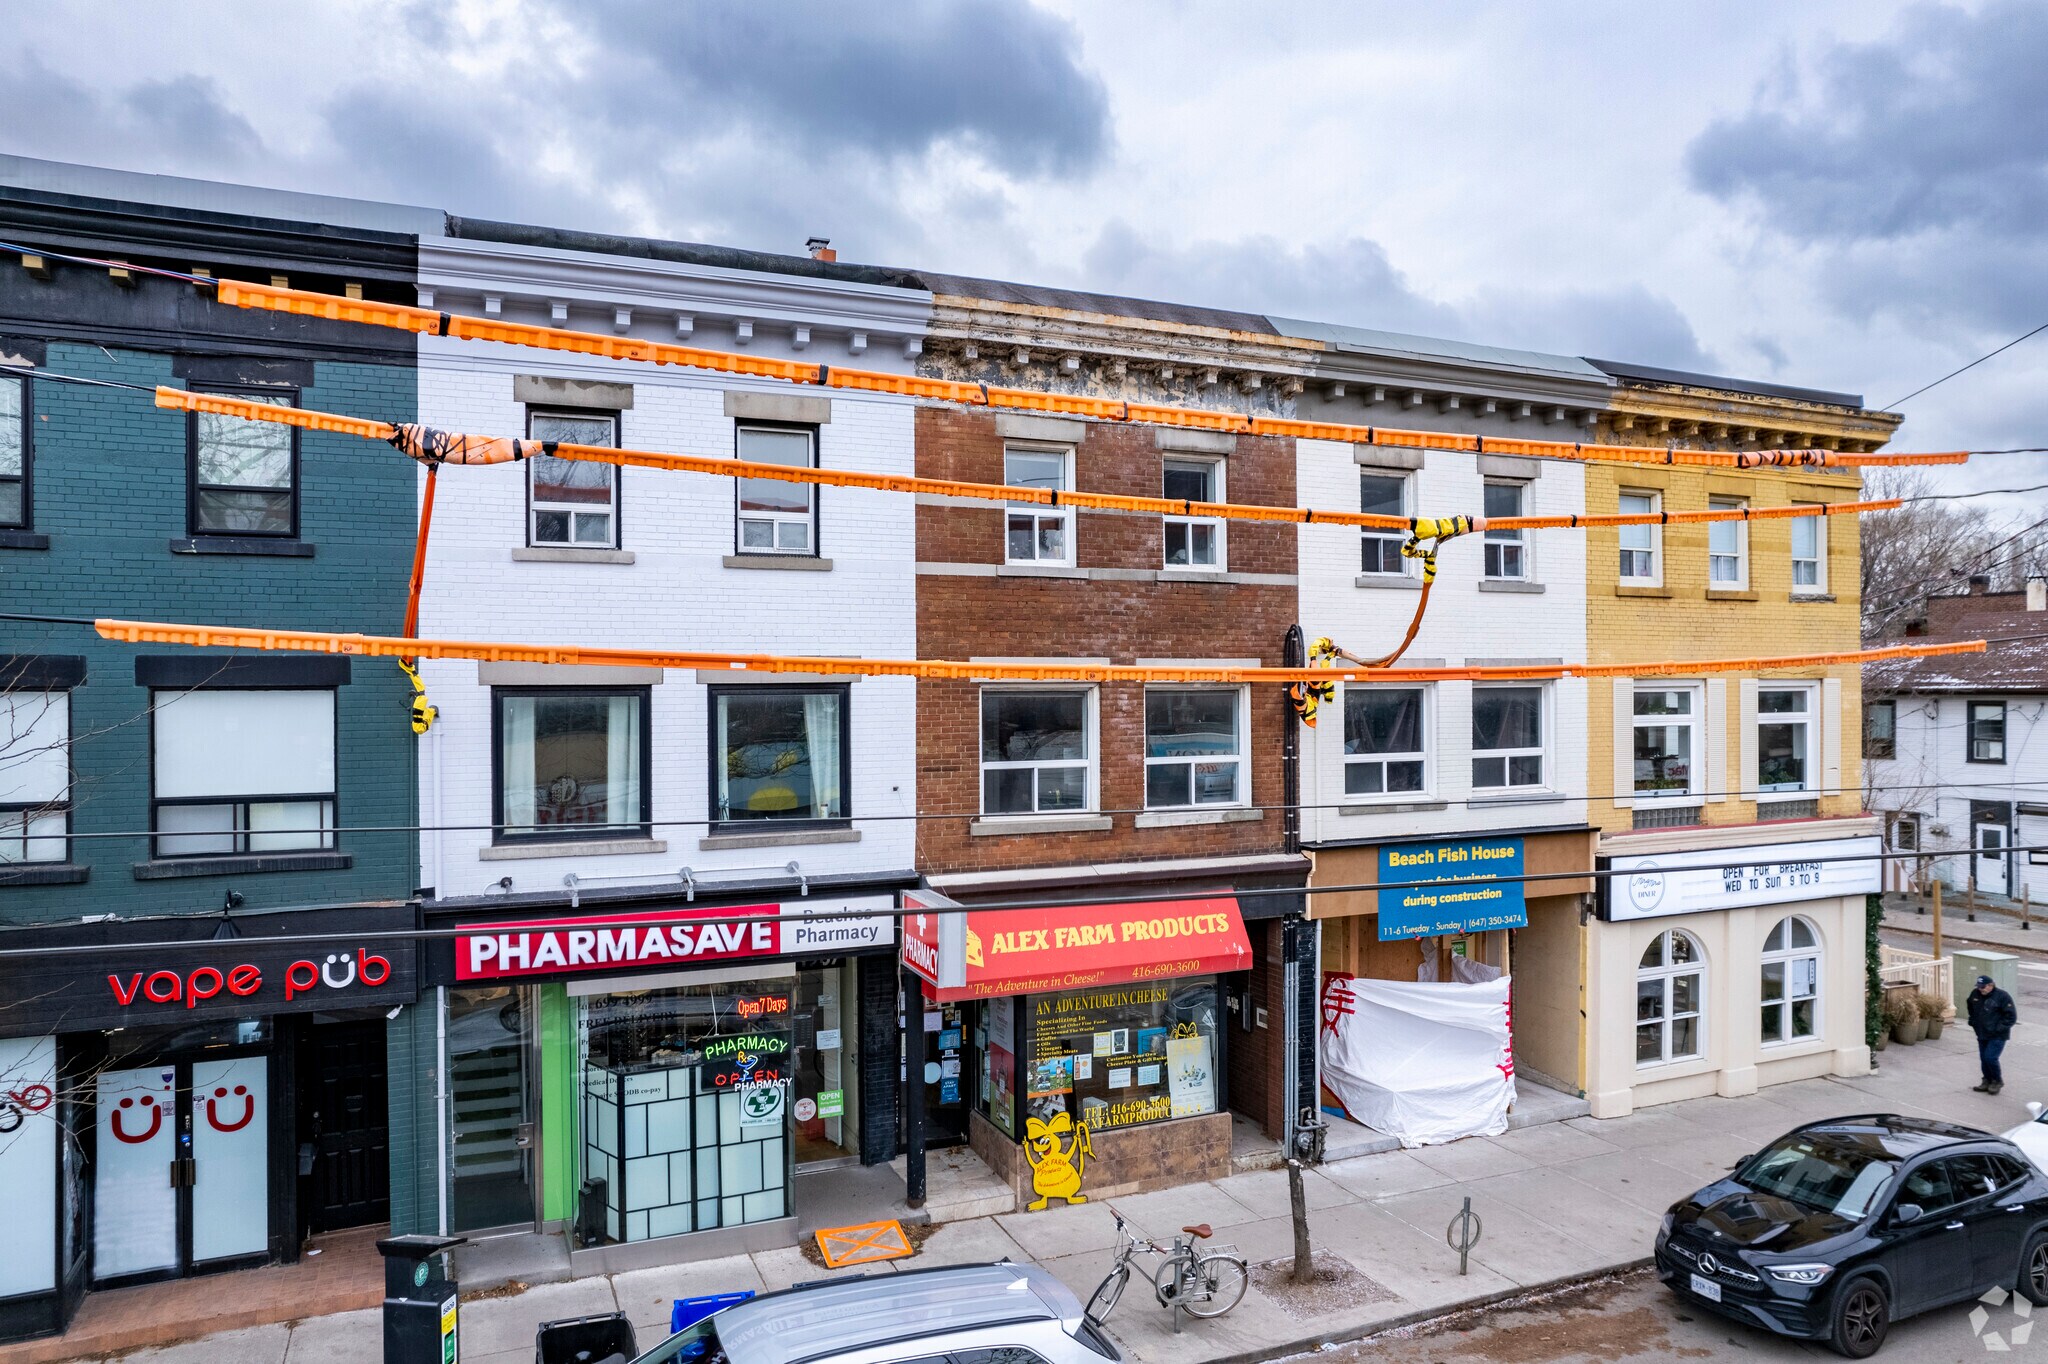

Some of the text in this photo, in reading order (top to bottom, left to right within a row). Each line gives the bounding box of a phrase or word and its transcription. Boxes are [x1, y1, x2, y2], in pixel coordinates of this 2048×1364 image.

[1389, 846, 1515, 867] Beach Fish House
[1722, 866, 1744, 879] OPEN
[1725, 880, 1742, 892] WED
[1749, 878, 1759, 890] TO
[1789, 875, 1795, 886] 9
[1799, 873, 1811, 885] TO
[1814, 872, 1820, 883] 9
[1403, 888, 1502, 907] during construction
[1638, 890, 1656, 898] DINER
[796, 926, 878, 943] Pharmacy
[991, 913, 1229, 955] ALEX FARM PRODUCTS
[1384, 927, 1401, 936] 11-6
[1402, 923, 1430, 934] Tuesday
[1436, 920, 1462, 931] Sunday
[1468, 917, 1487, 928] (647)
[1488, 914, 1522, 926] 350-3474
[469, 919, 772, 973] PHARMASAVE
[905, 933, 938, 976] PHARMACY
[108, 964, 263, 1009] vape
[968, 960, 1201, 995] "The Adventure in Cheese!" 416-690-3600
[738, 995, 787, 1018] Open 7 Days
[1036, 988, 1168, 1015] AN ADVENTURE IN CHEESE
[1036, 1016, 1077, 1026] Specializing
[705, 1035, 788, 1060] PHARMACY
[715, 1069, 778, 1086] OPEN
[734, 1078, 792, 1092] PHARMACY
[820, 1092, 840, 1101] OPEN
[1110, 1096, 1171, 1115] 416-690-3600
